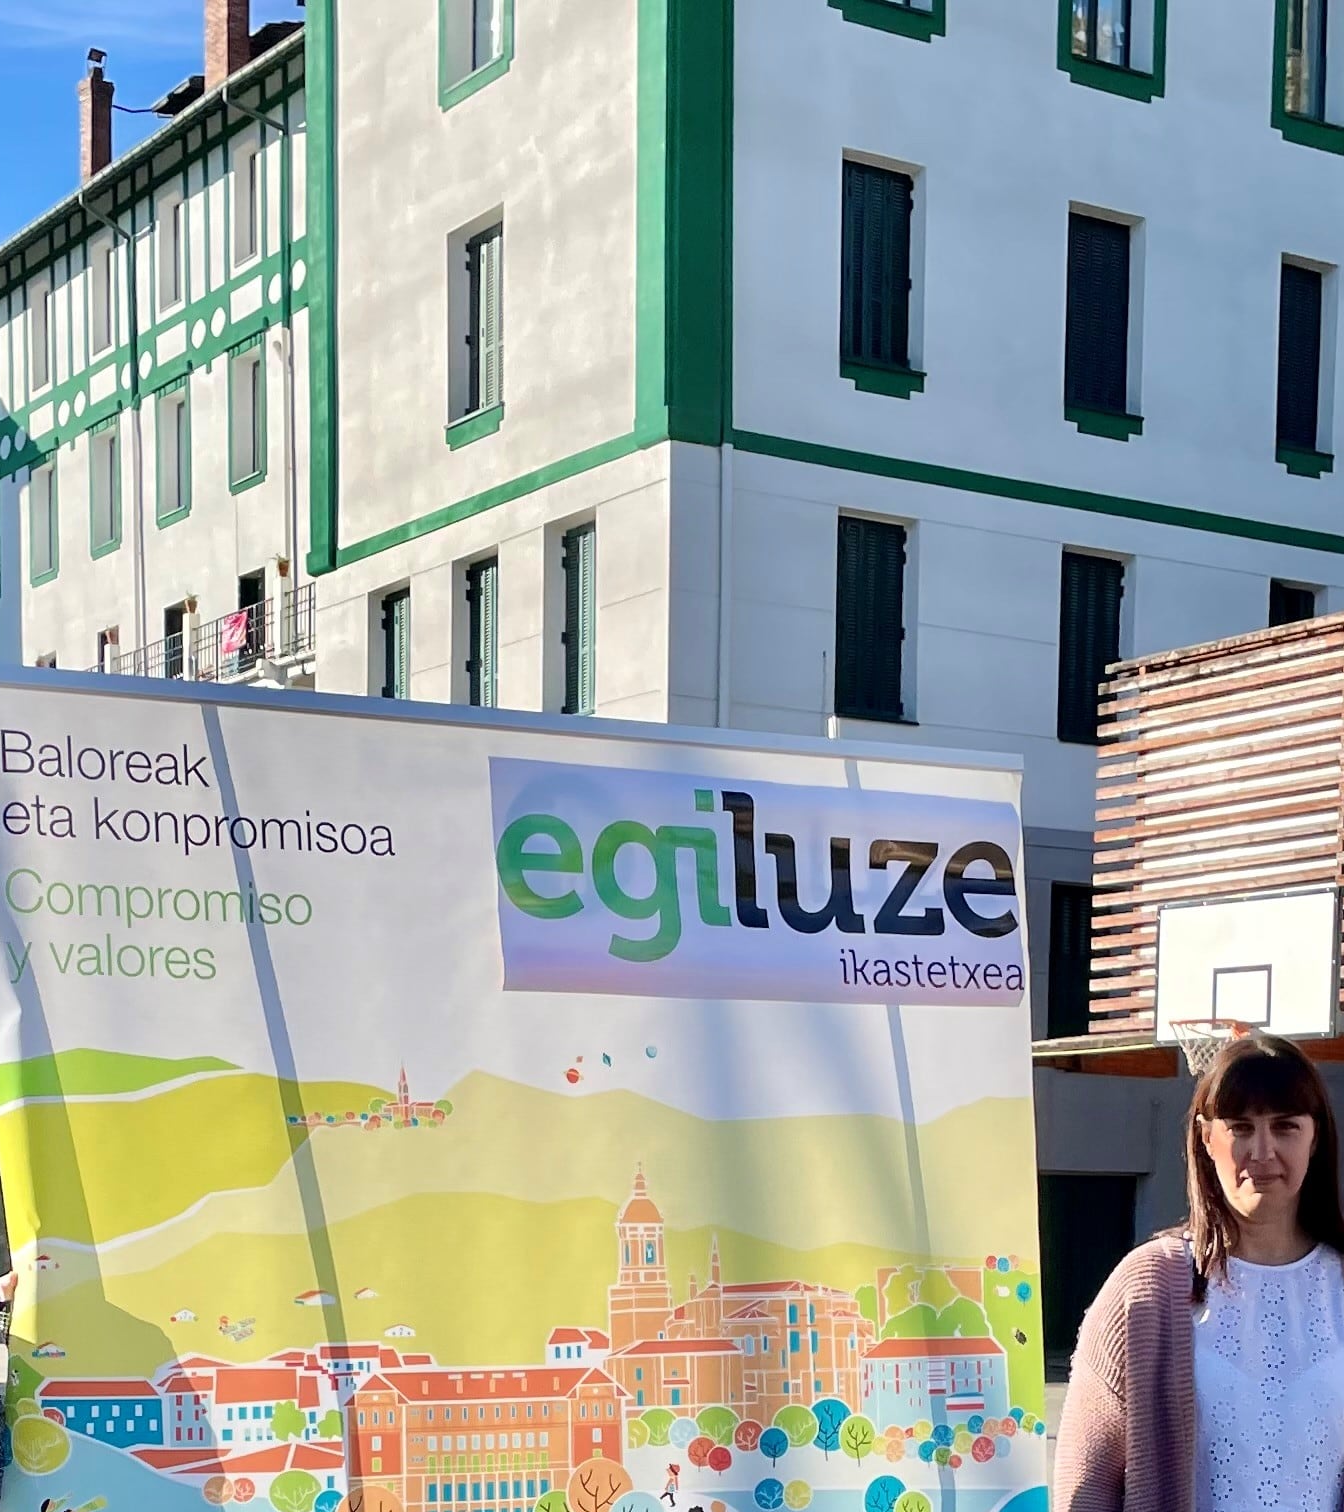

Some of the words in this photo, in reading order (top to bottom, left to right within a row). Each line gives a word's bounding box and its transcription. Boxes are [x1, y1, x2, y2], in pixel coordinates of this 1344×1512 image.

[0, 729, 210, 788] Baloreak
[2, 795, 76, 838] eta
[94, 797, 396, 857] konpromisoa
[5, 868, 313, 928] Compromiso
[496, 789, 1019, 963] egiluze
[6, 940, 33, 984] y
[49, 933, 217, 980] valores
[840, 948, 1025, 991] ikastetxea
